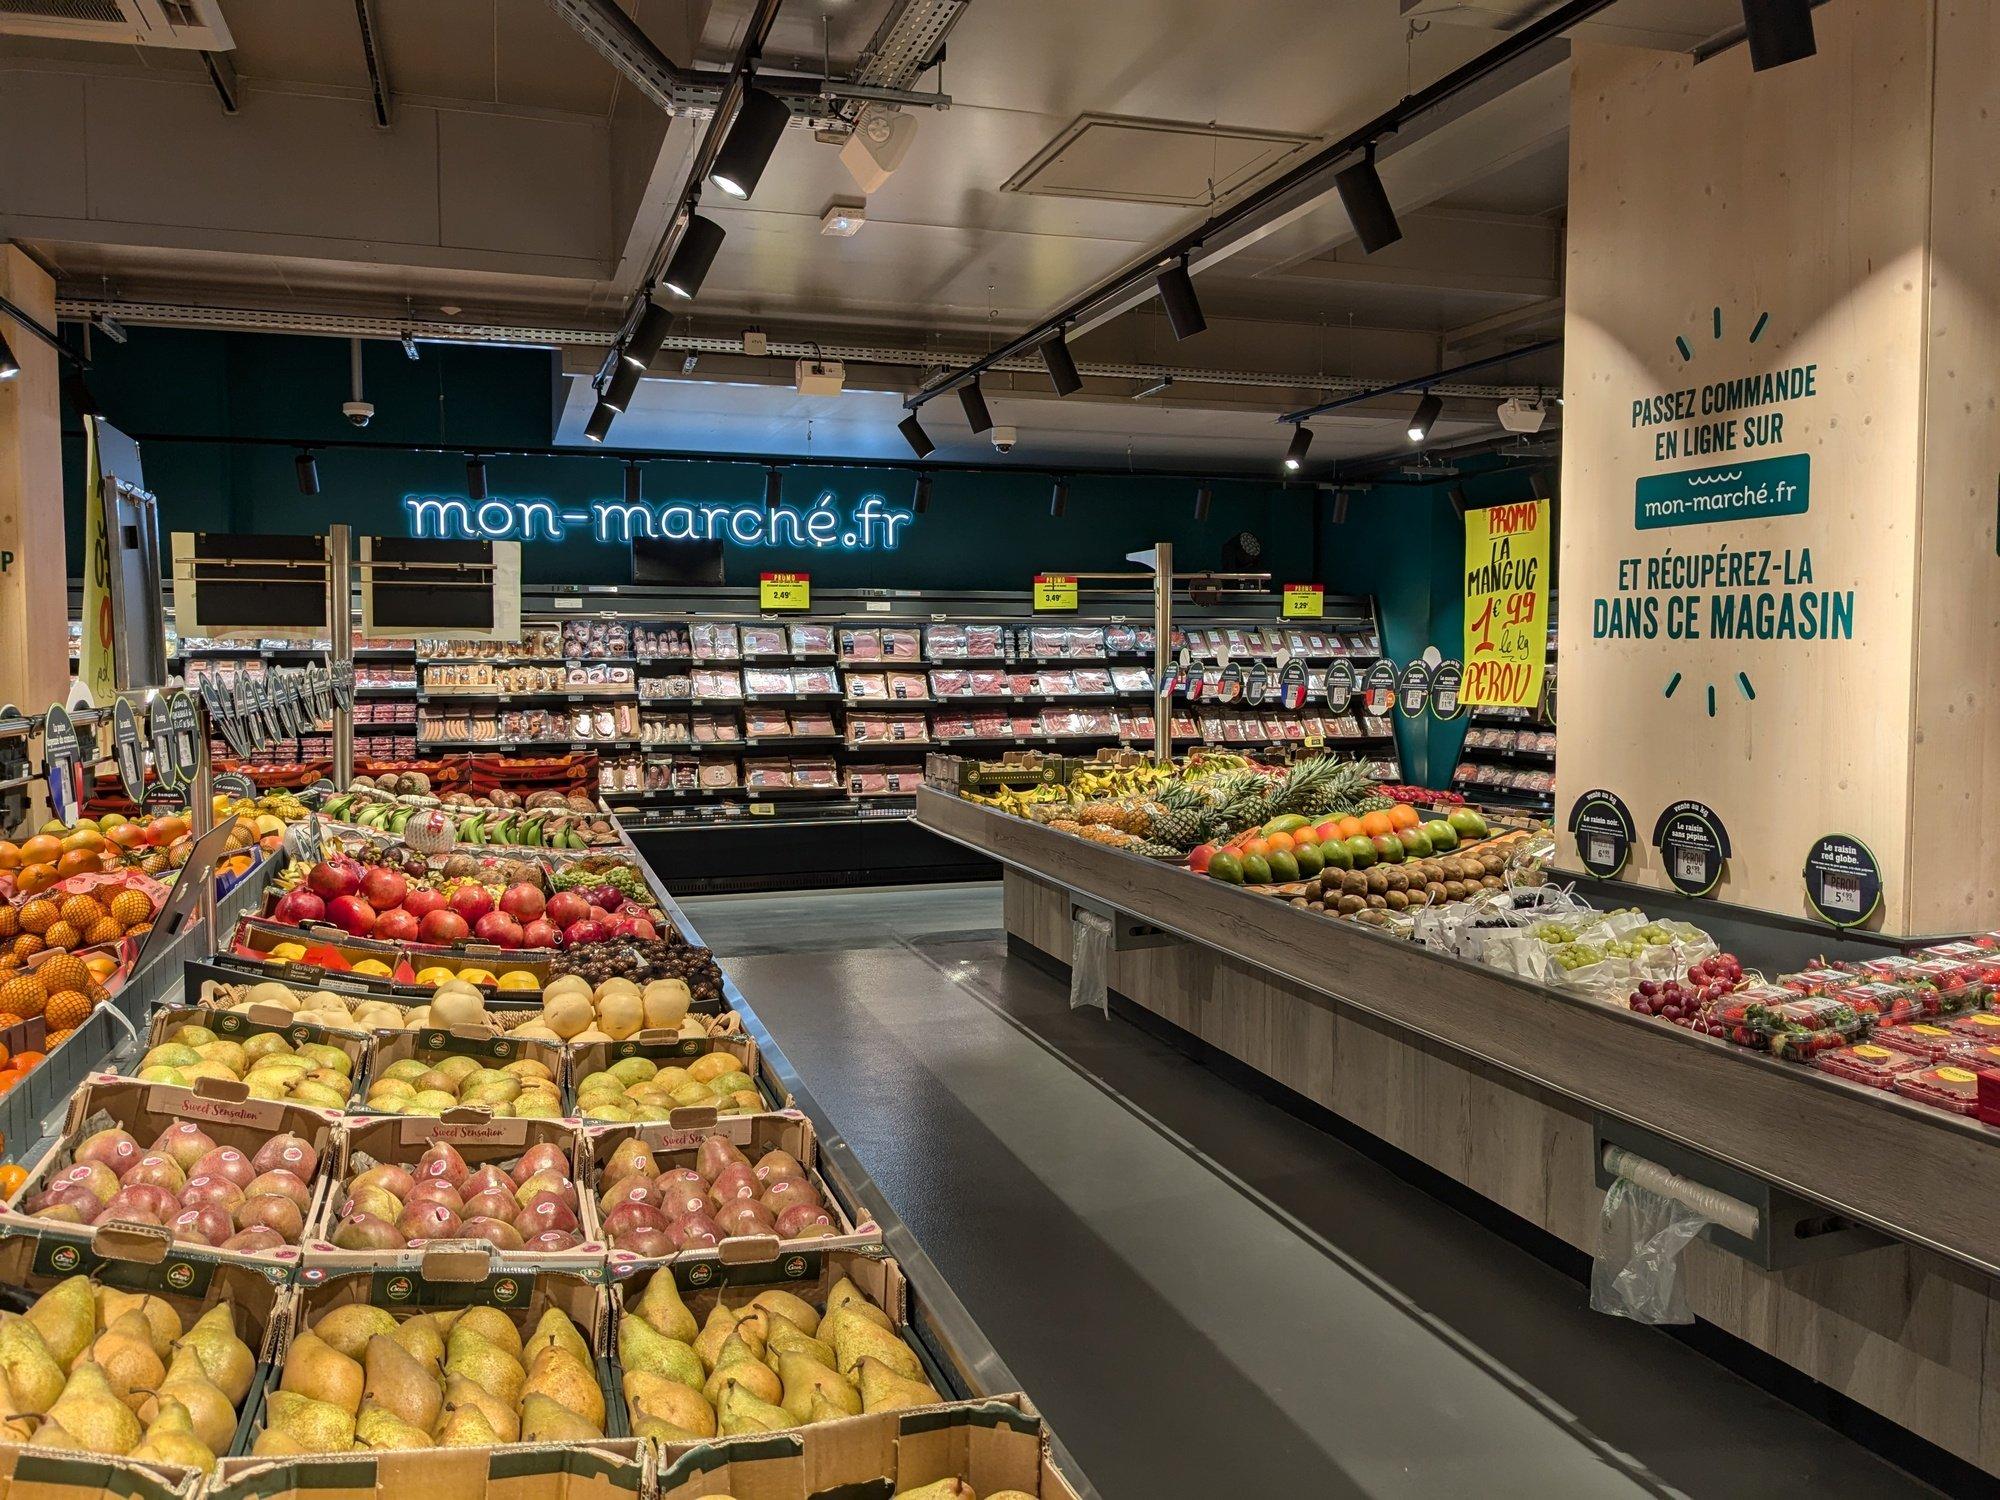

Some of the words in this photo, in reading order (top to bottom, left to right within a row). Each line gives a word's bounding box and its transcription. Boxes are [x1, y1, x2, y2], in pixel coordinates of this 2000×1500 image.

[1631, 387, 1696, 428] PASSEZ
[1701, 364, 1818, 415] COMMANDE
[1655, 432, 1678, 461] EN
[1683, 420, 1738, 457] LIGNE
[1743, 412, 1784, 449] SUR
[1644, 480, 1797, 517] mon-marché.fr
[404, 489, 913, 549] mon-marché.fr
[1488, 501, 1538, 534] PROMO
[1491, 537, 1510, 563] LA
[1467, 557, 1538, 597] MANGUE
[1619, 557, 1642, 591] ET
[1647, 544, 1813, 590] RÉCUPÉREZ-LA
[1593, 596, 1658, 639] DANS
[1667, 595, 1700, 639] CE
[1710, 591, 1855, 640] MAGASIN
[1464, 660, 1533, 704] PEROU
[1583, 814, 1590, 822] Le
[1590, 816, 1606, 825] raisin
[1674, 802, 1690, 812] vente
[1700, 805, 1709, 818] kg
[1671, 830, 1686, 839] sans
[1686, 832, 1709, 842] pépins.
[1677, 822, 1685, 830] Le
[1685, 824, 1703, 833] raisin
[1821, 852, 1834, 861] red
[1835, 854, 1860, 864] globe.
[1823, 842, 1833, 851] Le
[1834, 845, 1857, 855] raisin
[1830, 876, 1857, 893] PEROU
[181, 1100, 211, 1114] Sweet
[212, 1104, 258, 1120] Sensation
[432, 1124, 458, 1138] Sweet
[460, 1126, 504, 1138] Sensation
[662, 1135, 686, 1147] Sweet
